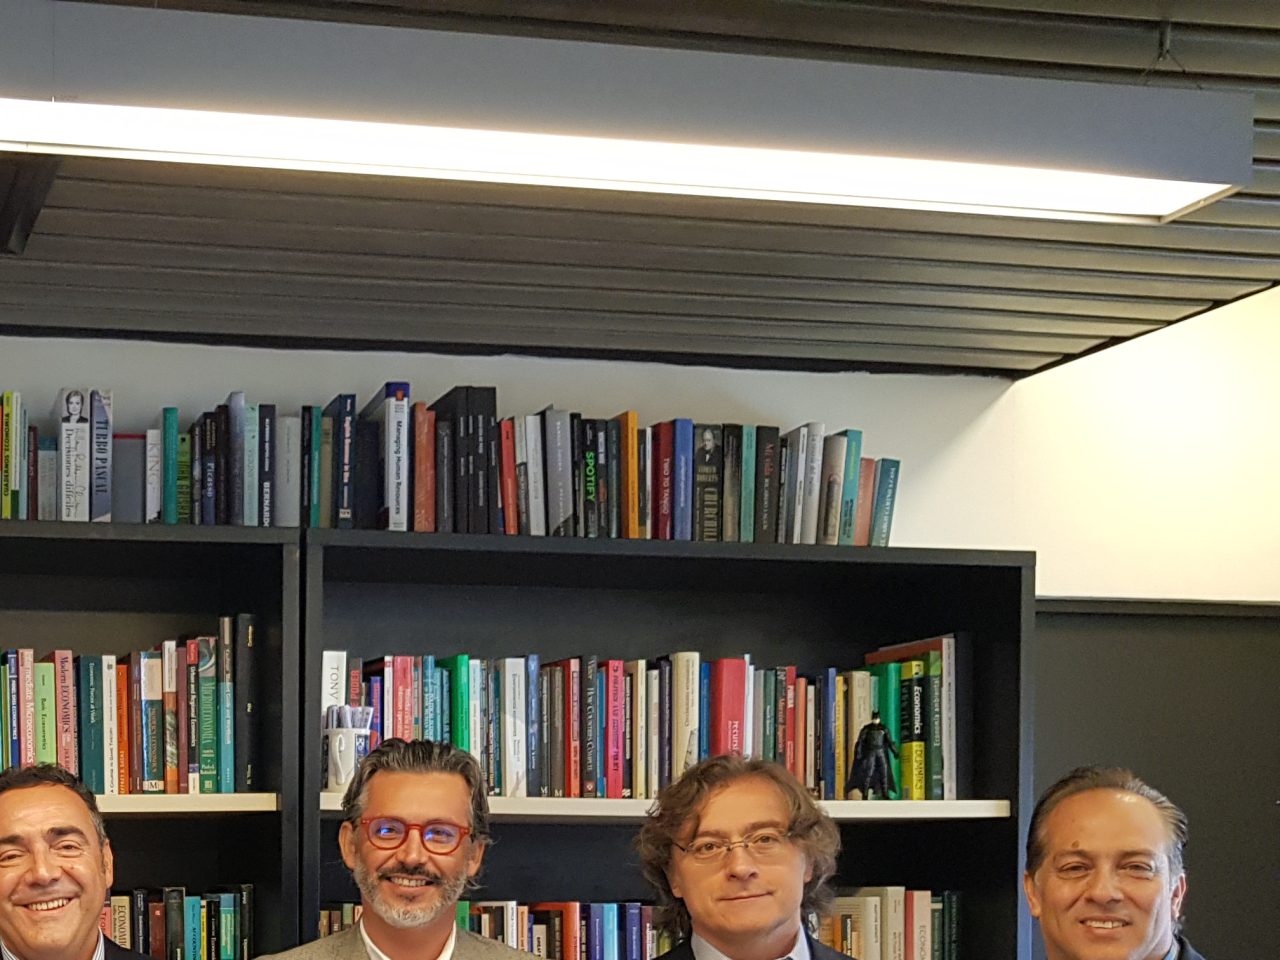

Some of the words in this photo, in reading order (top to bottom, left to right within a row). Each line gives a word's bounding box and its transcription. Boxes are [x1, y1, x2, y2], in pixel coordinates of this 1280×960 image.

[65, 428, 74, 478] Decisiones
[95, 420, 108, 454] TURBO
[95, 457, 108, 496] PASCAL
[206, 462, 215, 497] Picasso
[585, 451, 595, 502] SPOTIFY
[663, 478, 669, 487] TO
[65, 480, 75, 518] difíciles
[25, 651, 34, 700] Intermediate
[329, 666, 339, 700] TONY
[61, 685, 70, 733] ECONOMICS
[914, 686, 922, 734] Economics
[25, 702, 35, 763] Microeconomics
